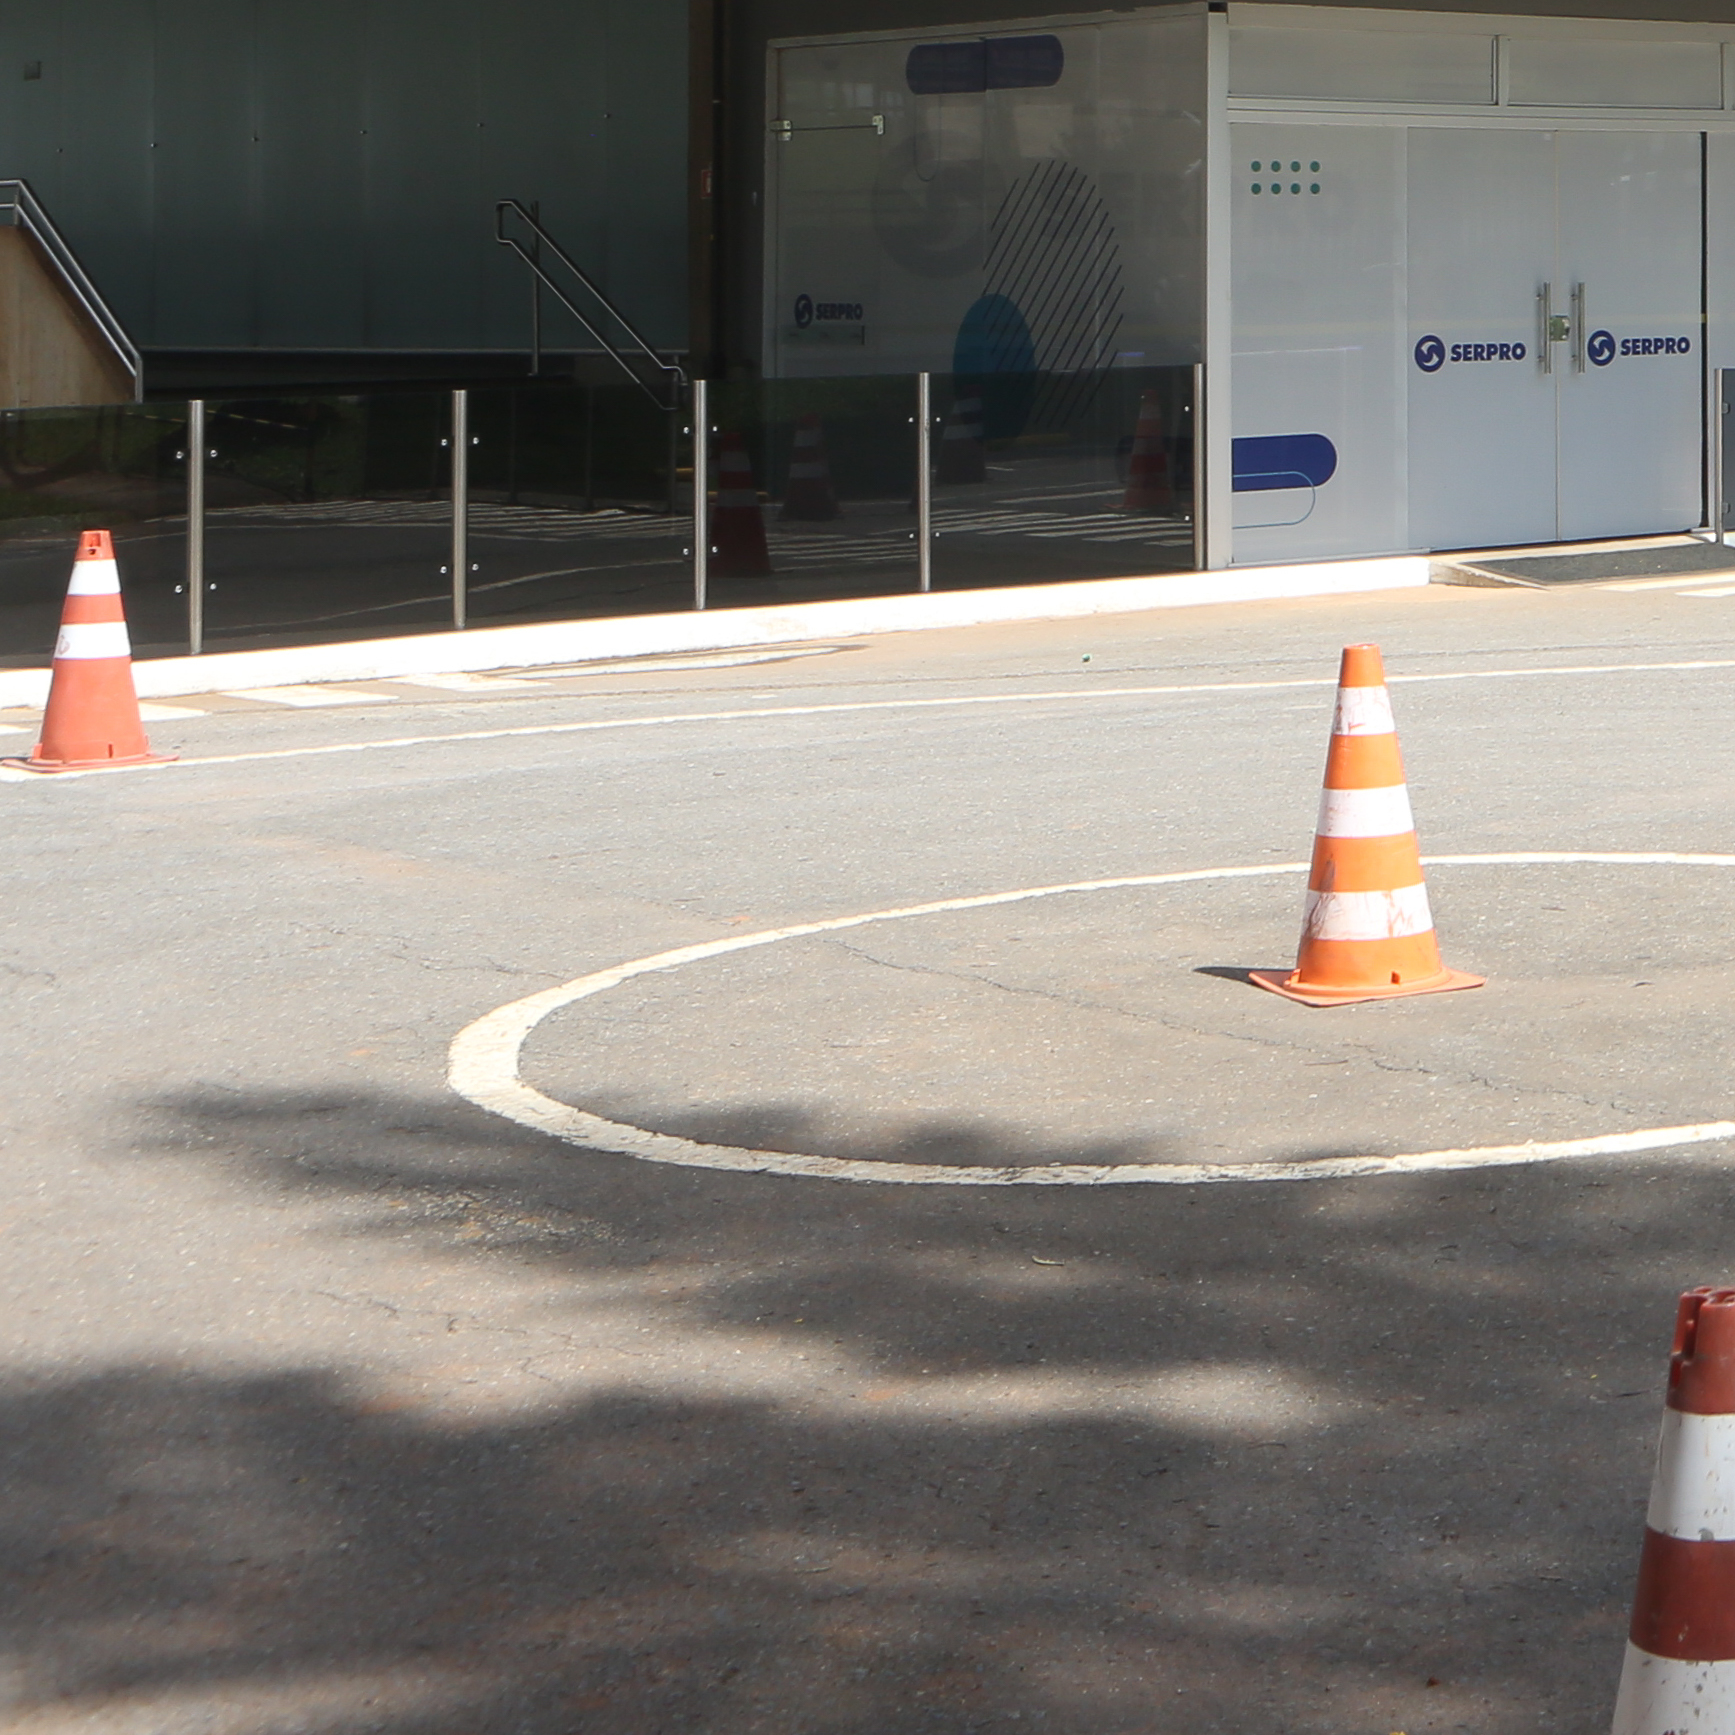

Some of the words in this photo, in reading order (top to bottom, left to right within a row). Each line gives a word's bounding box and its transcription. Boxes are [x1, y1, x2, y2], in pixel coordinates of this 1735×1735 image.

[815, 302, 864, 321] SERPRO
[1450, 342, 1527, 363] SERPRO
[1620, 336, 1692, 357] SERPRO
